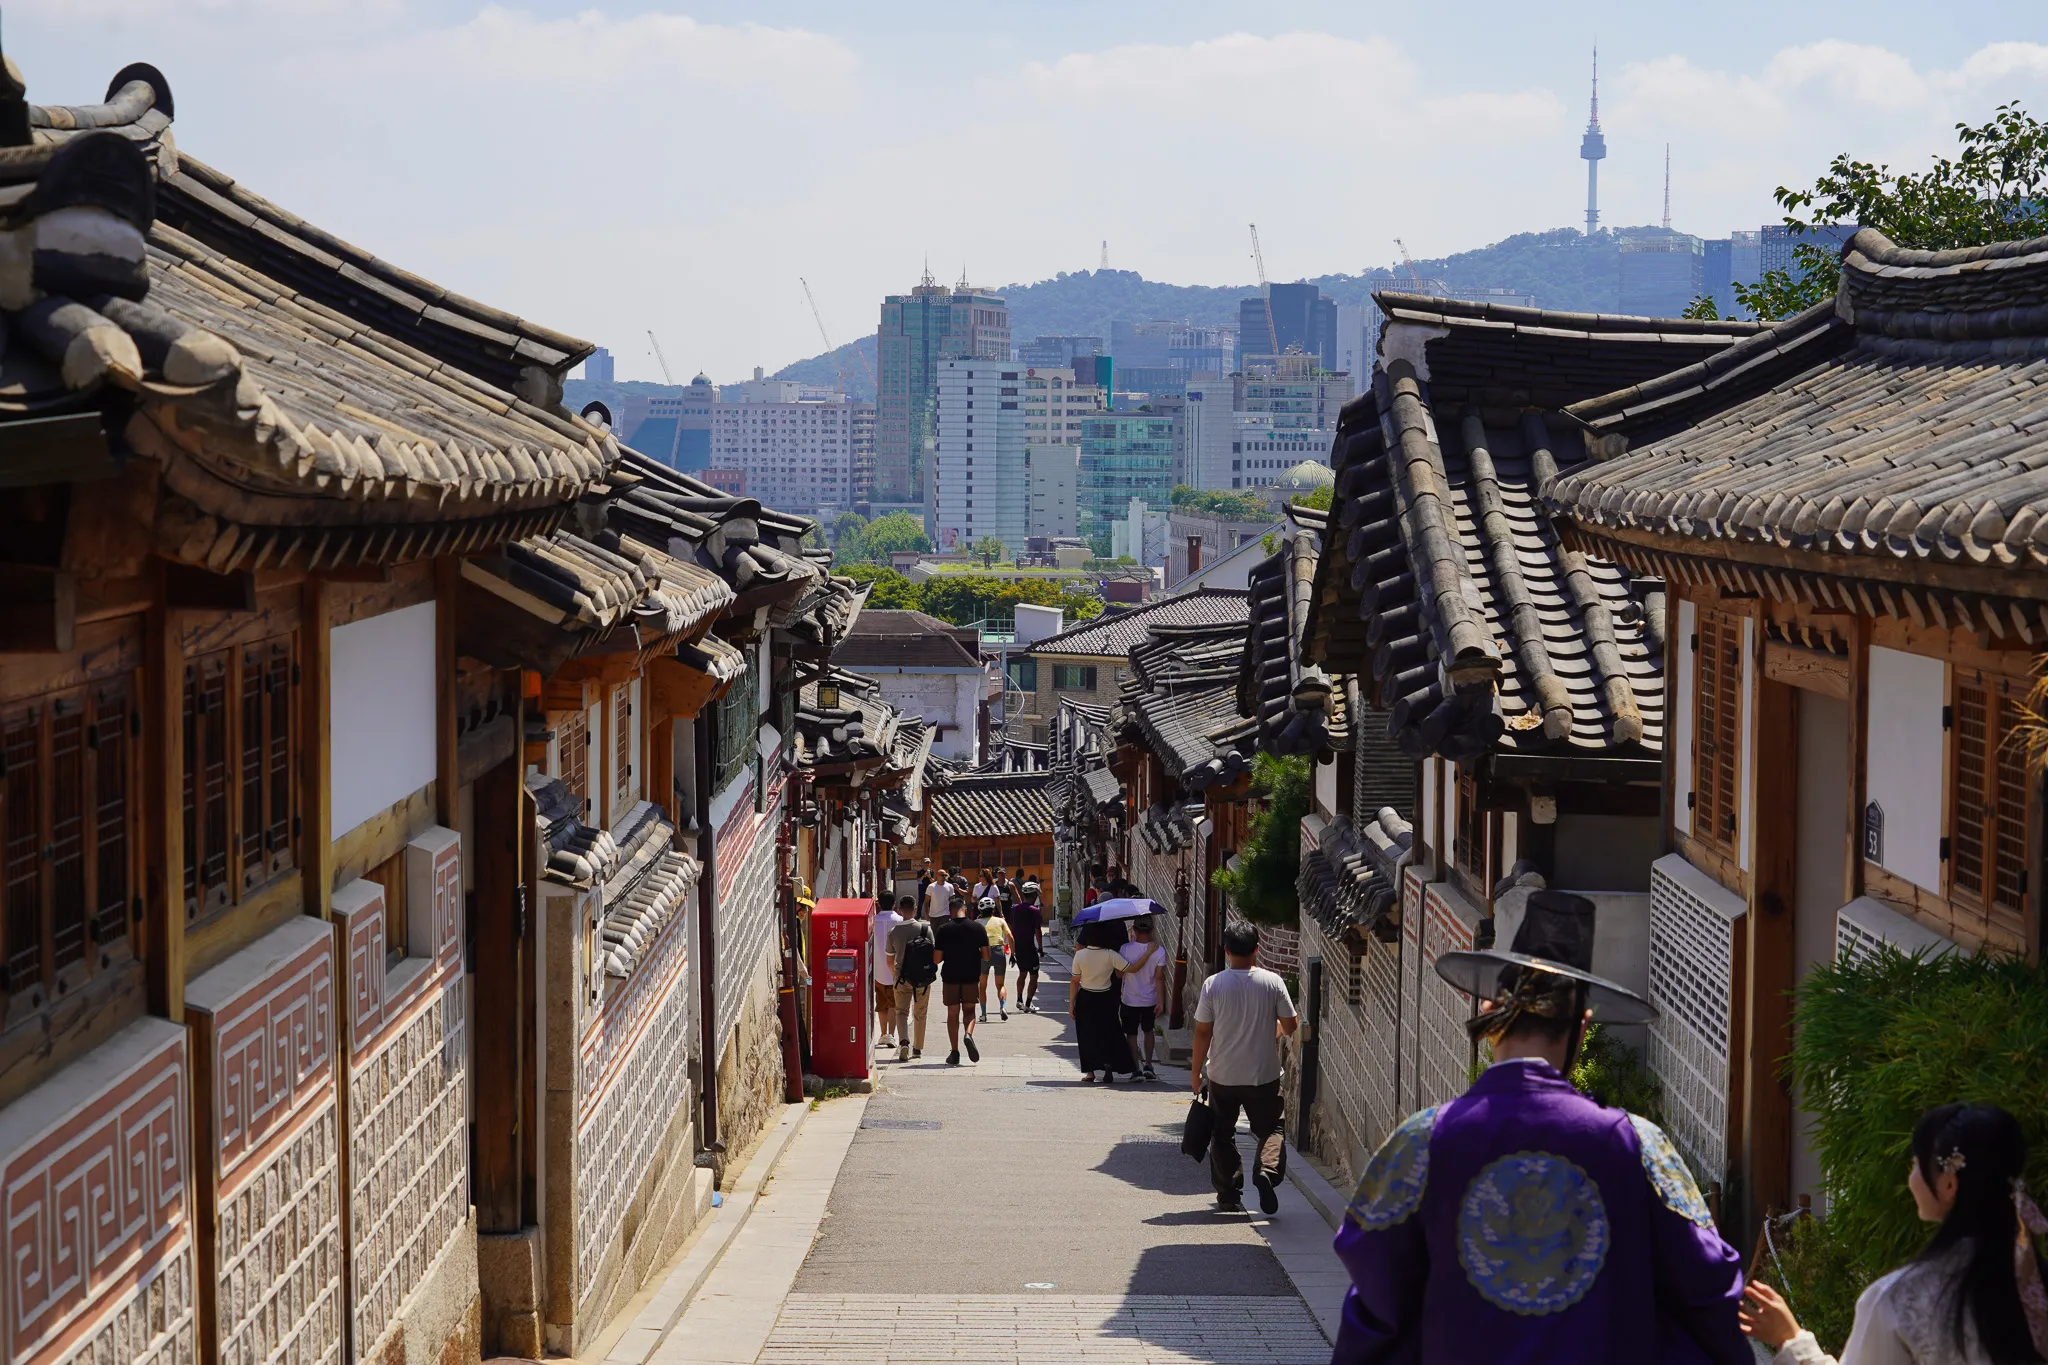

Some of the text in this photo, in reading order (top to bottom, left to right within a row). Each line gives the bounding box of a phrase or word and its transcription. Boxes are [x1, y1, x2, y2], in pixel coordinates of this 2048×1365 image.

[928, 296, 954, 304] SUITES
[1278, 432, 1308, 442] 하나은행
[1868, 830, 1878, 855] 53
